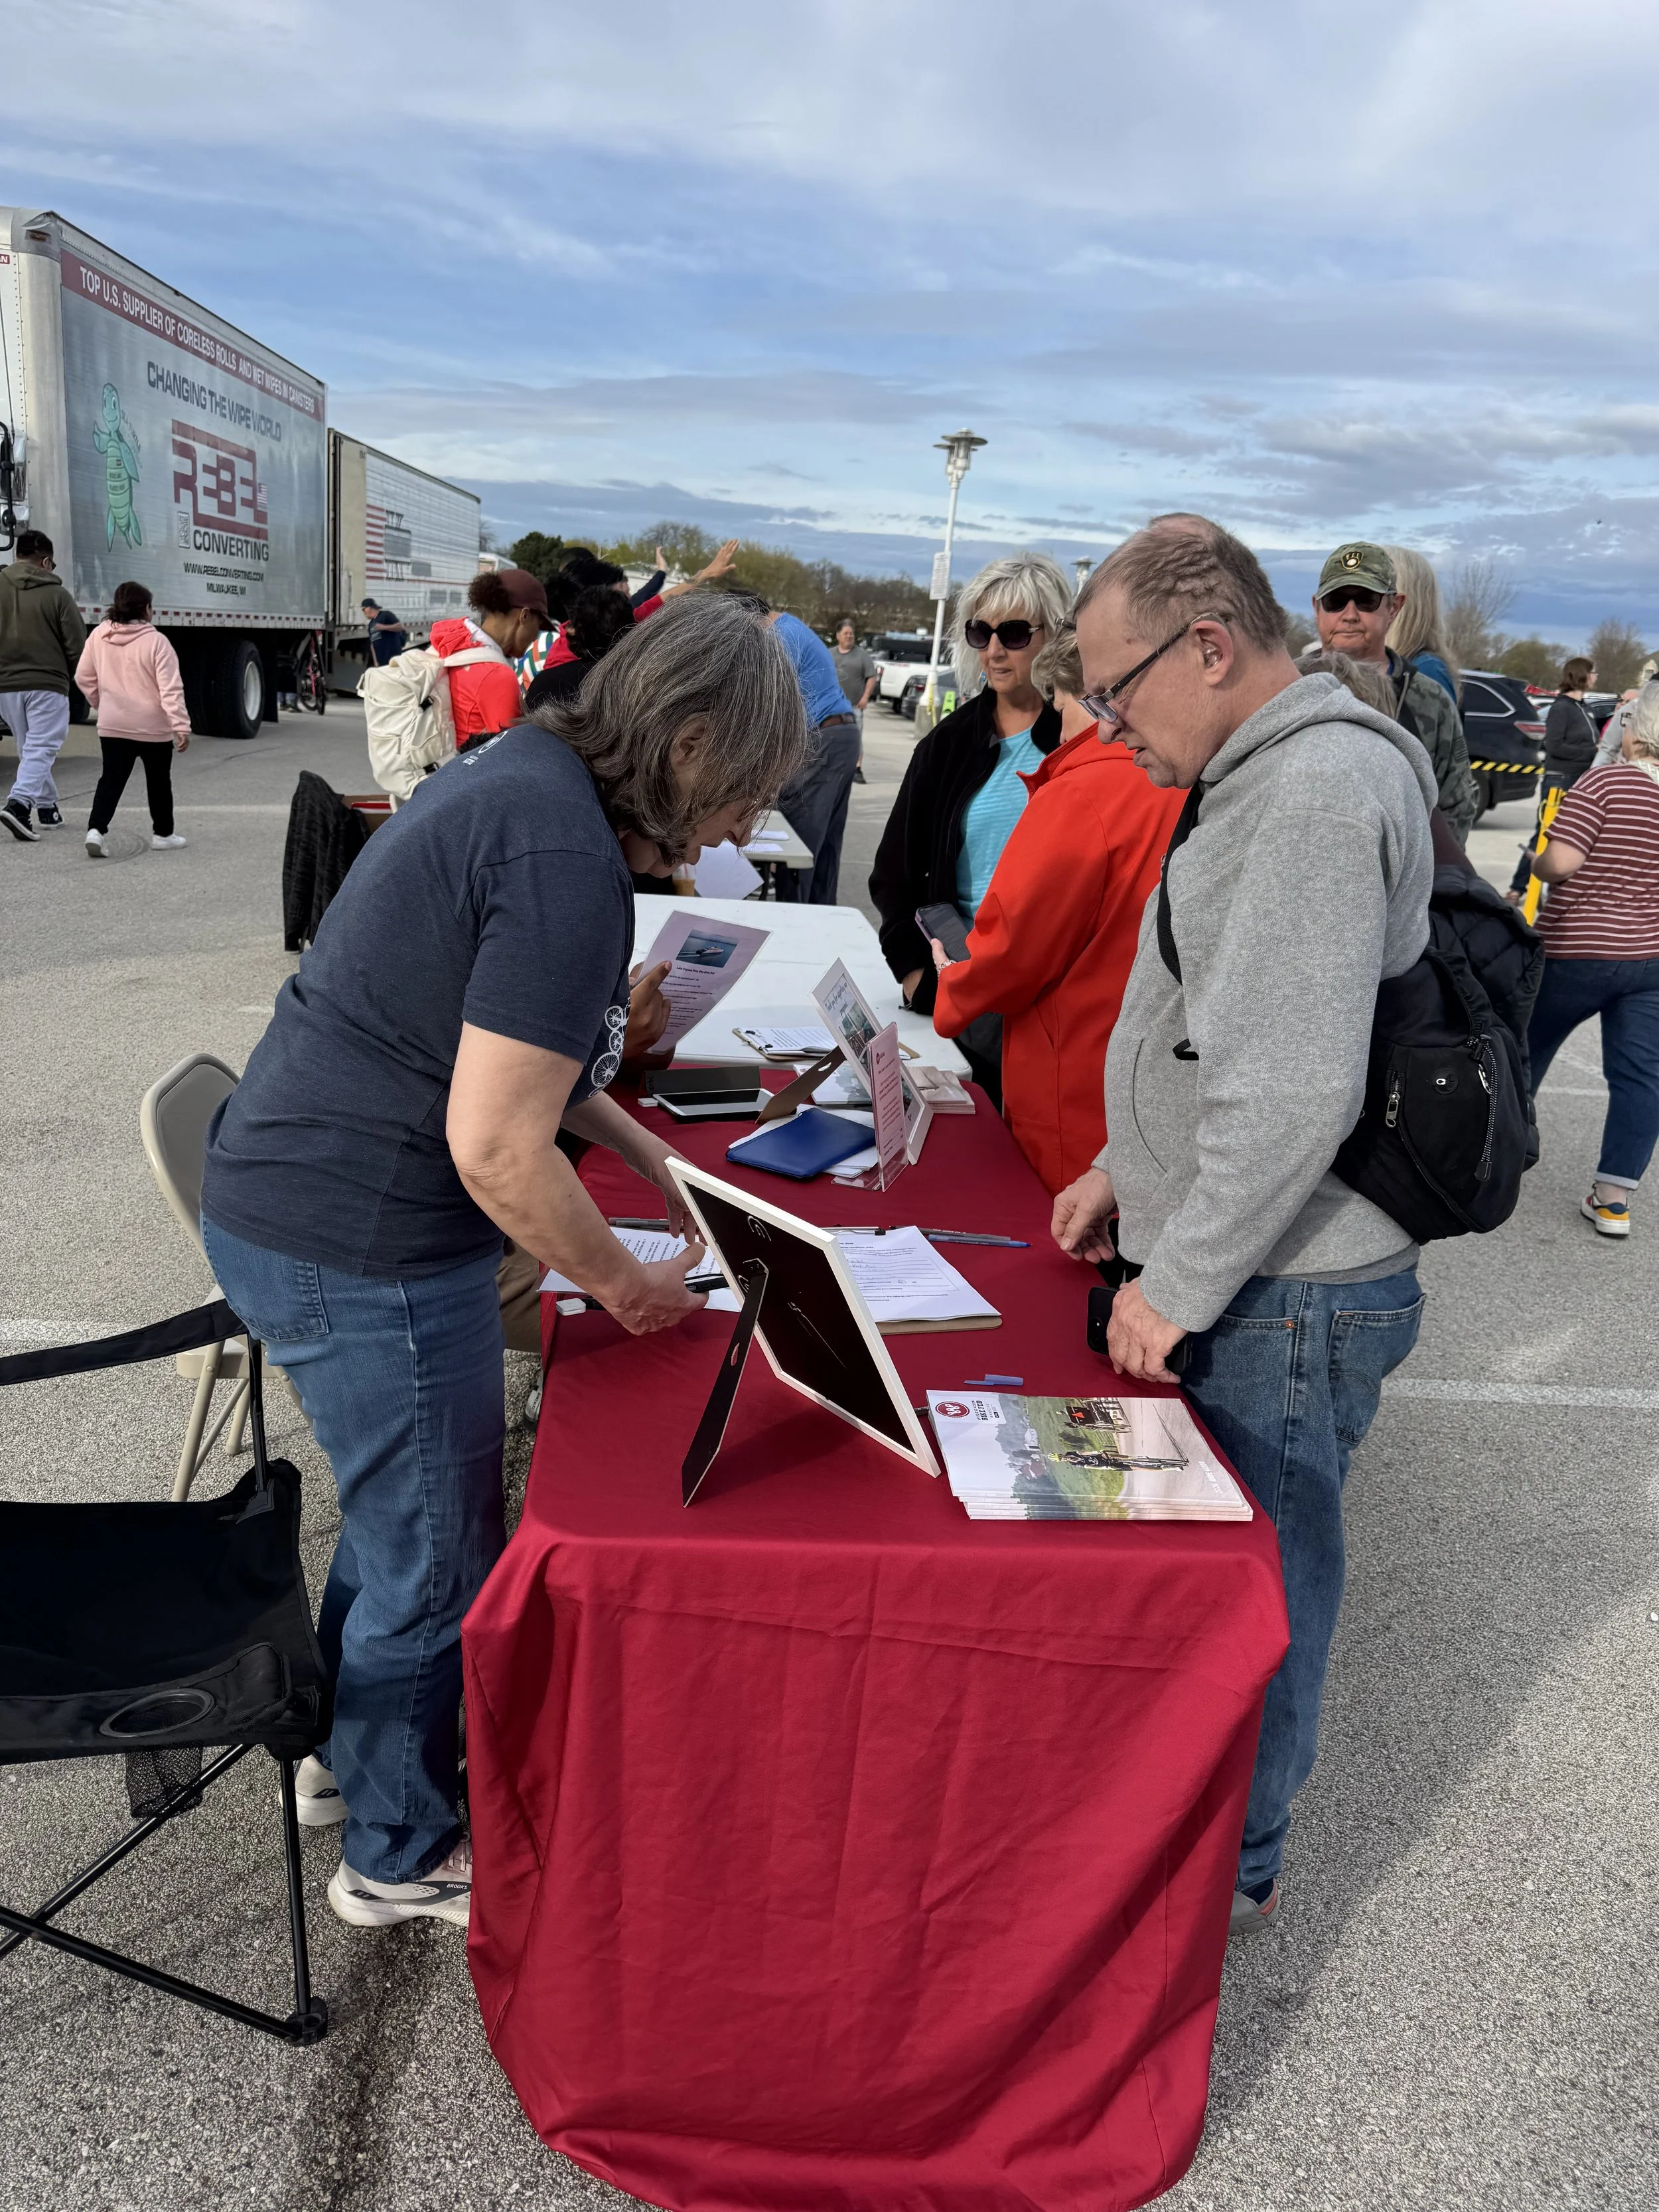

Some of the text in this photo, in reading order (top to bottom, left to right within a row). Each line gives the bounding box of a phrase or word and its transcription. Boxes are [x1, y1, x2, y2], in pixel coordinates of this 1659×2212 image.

[80, 266, 315, 413] TOP U.S. SUPPLIER OF CORELESS ROLLS AND WET WIPES IN CANISTERS
[147, 360, 282, 443] CHANGING THE WIPE WORLD
[172, 419, 268, 542] REBEL
[193, 530, 269, 562] CONVERTING
